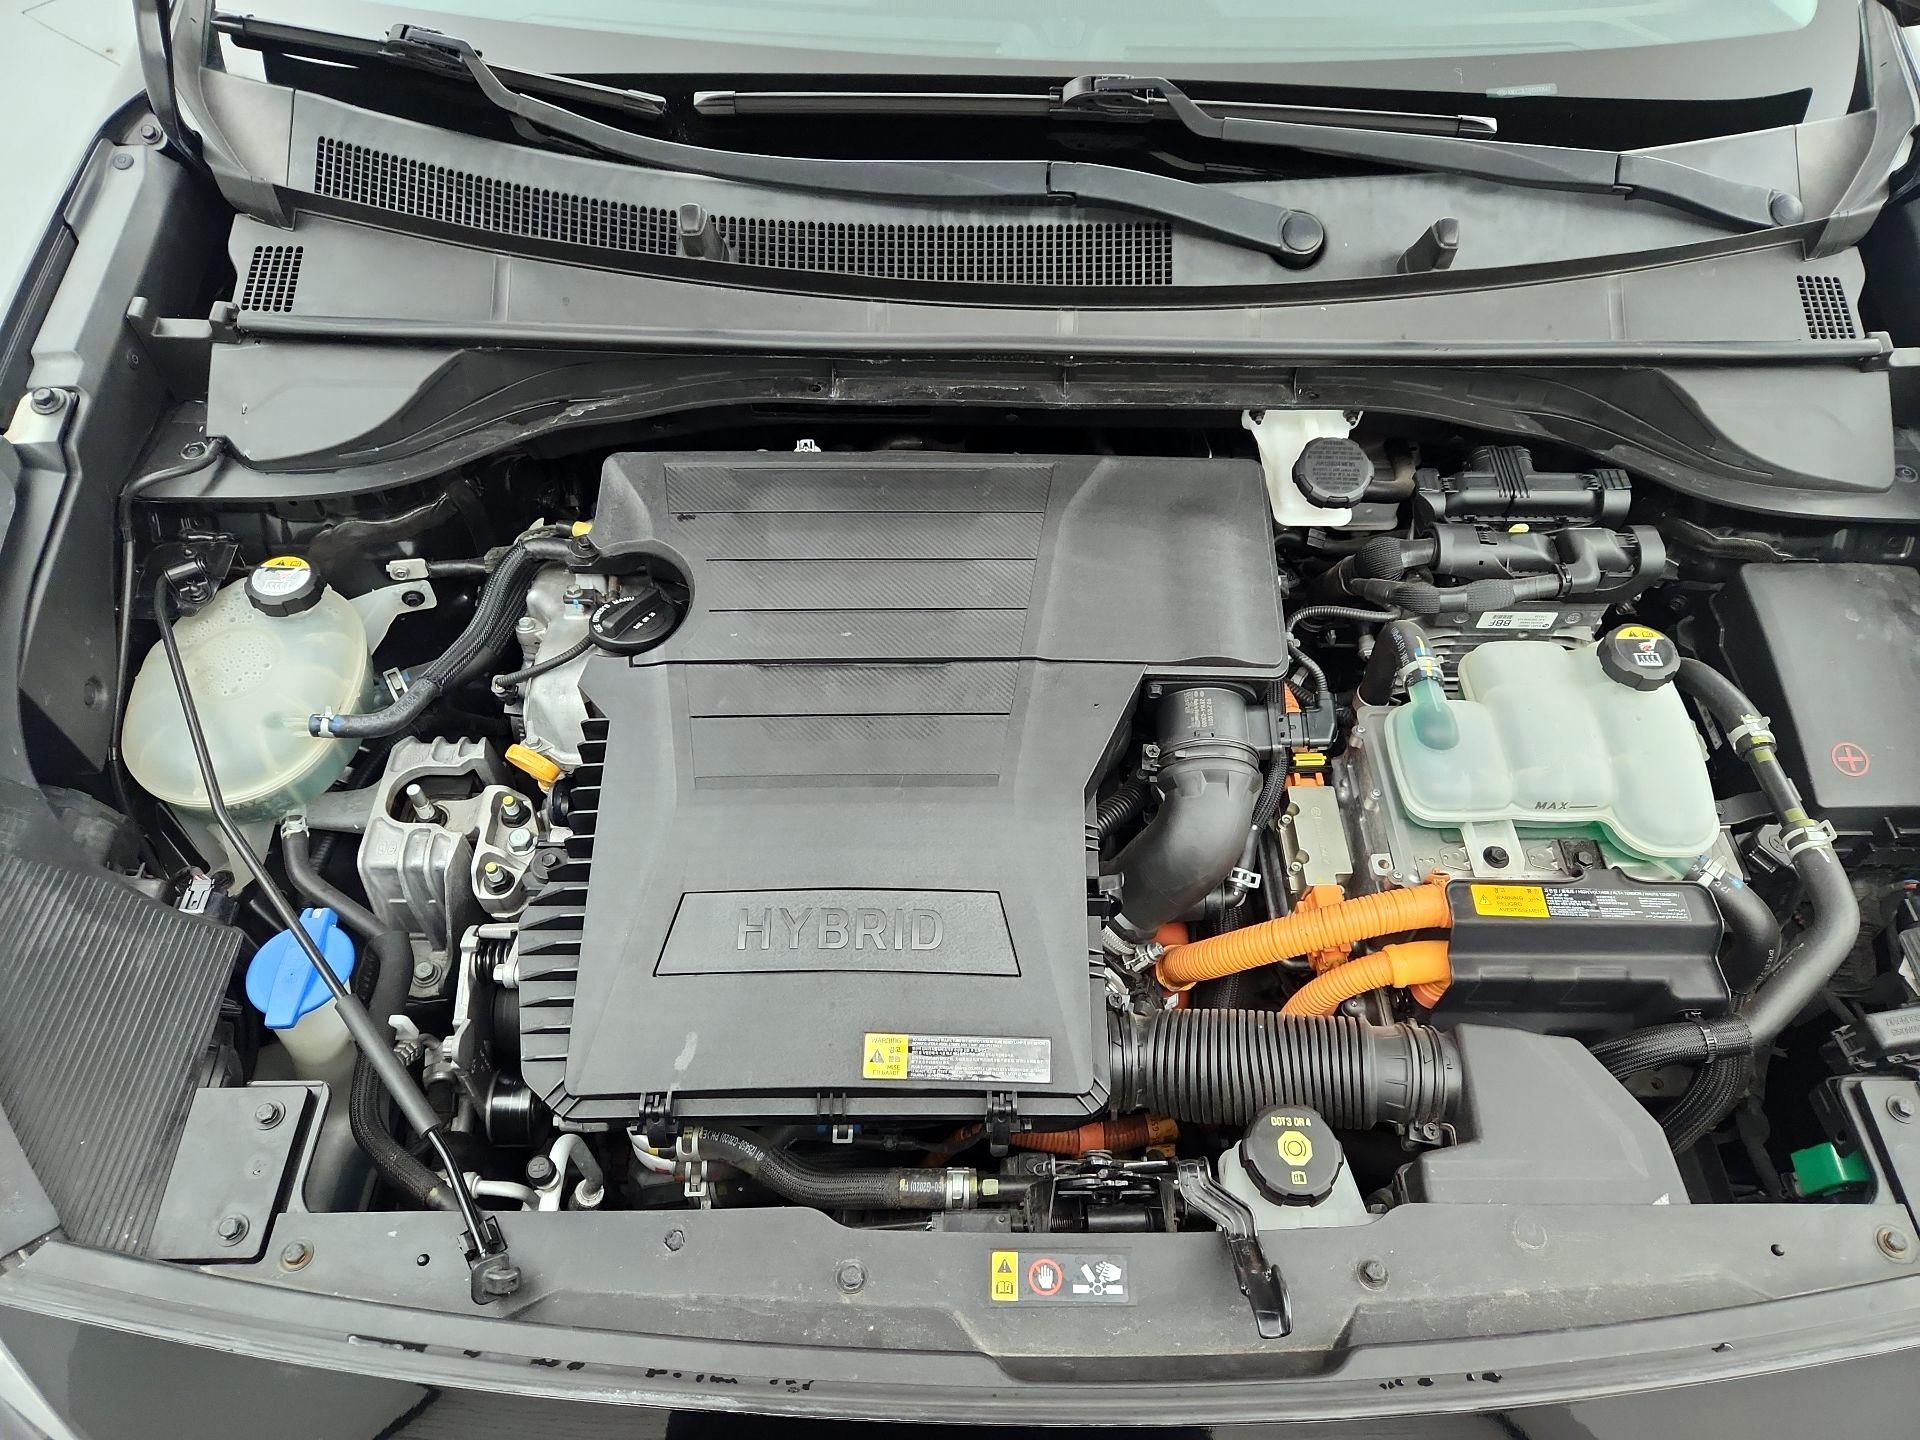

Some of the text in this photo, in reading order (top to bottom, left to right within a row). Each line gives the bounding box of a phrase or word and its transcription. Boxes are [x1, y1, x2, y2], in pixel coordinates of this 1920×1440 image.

[593, 624, 603, 633] SEE
[1534, 801, 1570, 810] MAX
[736, 907, 944, 951] HYBRID
[1294, 1117, 1305, 1126] OR
[1306, 1118, 1311, 1127] 4
